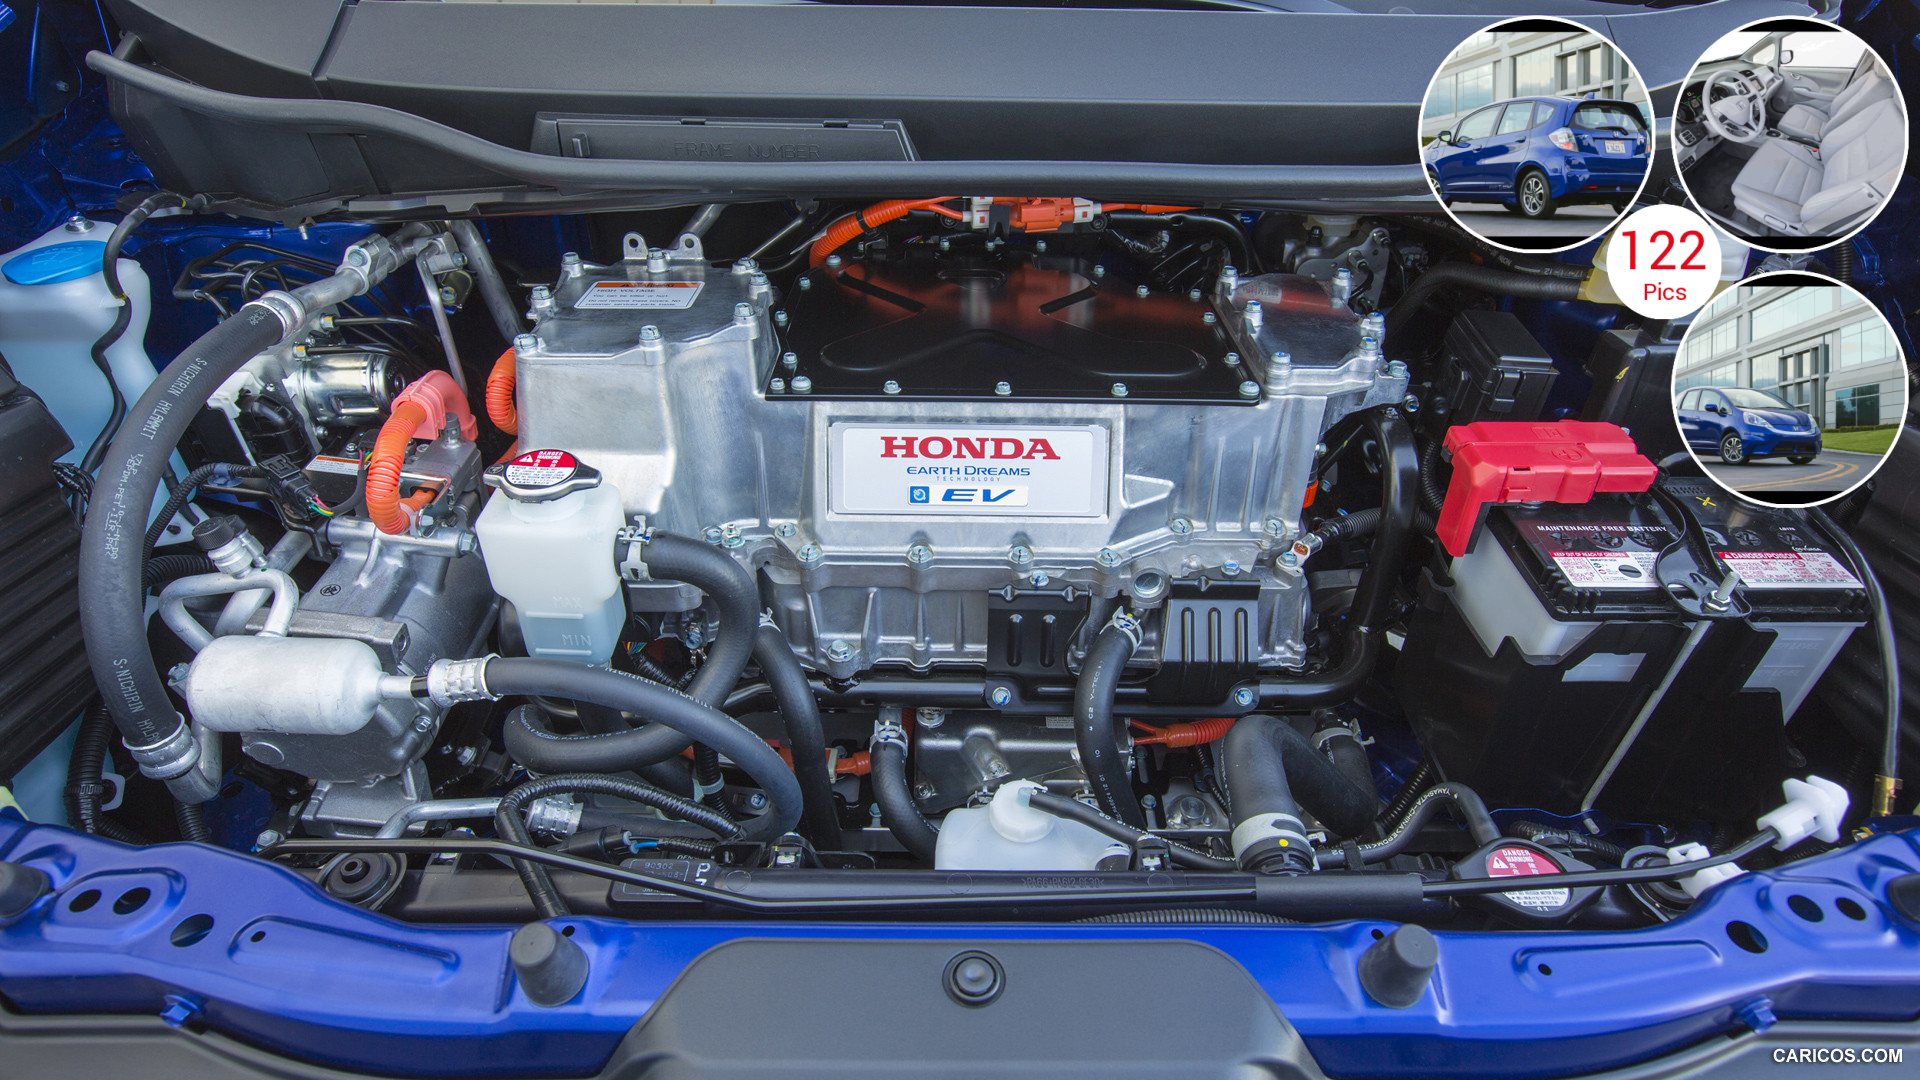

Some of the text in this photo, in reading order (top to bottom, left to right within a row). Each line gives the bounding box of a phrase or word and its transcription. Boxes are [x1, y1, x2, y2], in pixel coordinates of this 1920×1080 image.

[674, 142, 821, 159] FRAME NUMBER
[880, 436, 1061, 460] HONDA
[906, 466, 960, 475] EARTH
[941, 488, 1016, 503] EV
[552, 594, 583, 609] MAX
[561, 633, 592, 646] MIN
